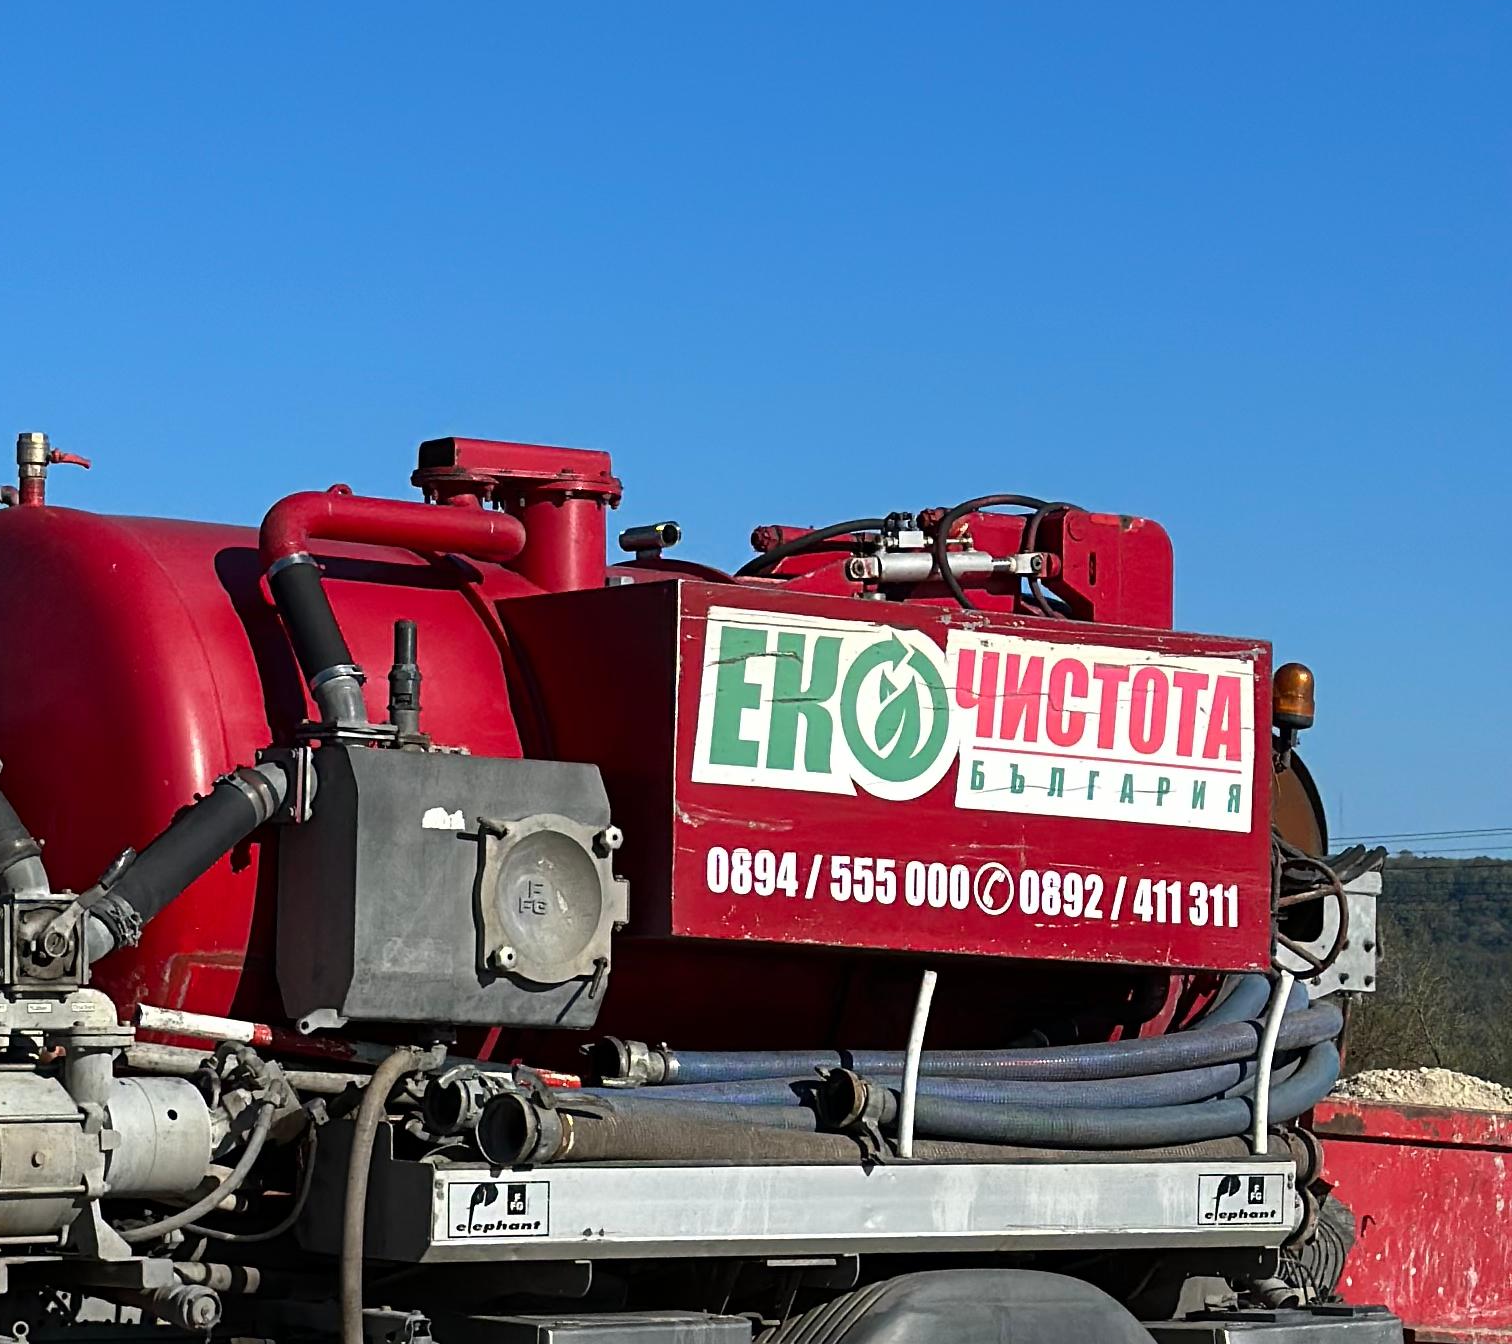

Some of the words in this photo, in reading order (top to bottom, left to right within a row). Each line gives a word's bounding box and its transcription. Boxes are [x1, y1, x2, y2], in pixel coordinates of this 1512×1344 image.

[709, 625, 949, 782] ЕКО
[955, 648, 1242, 762] ЧИСТОТА
[971, 758, 1242, 814] БЪЛГАРИЯ
[707, 847, 798, 897] 0894
[831, 856, 896, 905] 555
[905, 860, 970, 909] 000
[1019, 869, 1104, 920] 0892
[1133, 878, 1183, 924] 411
[1188, 881, 1239, 928] 311
